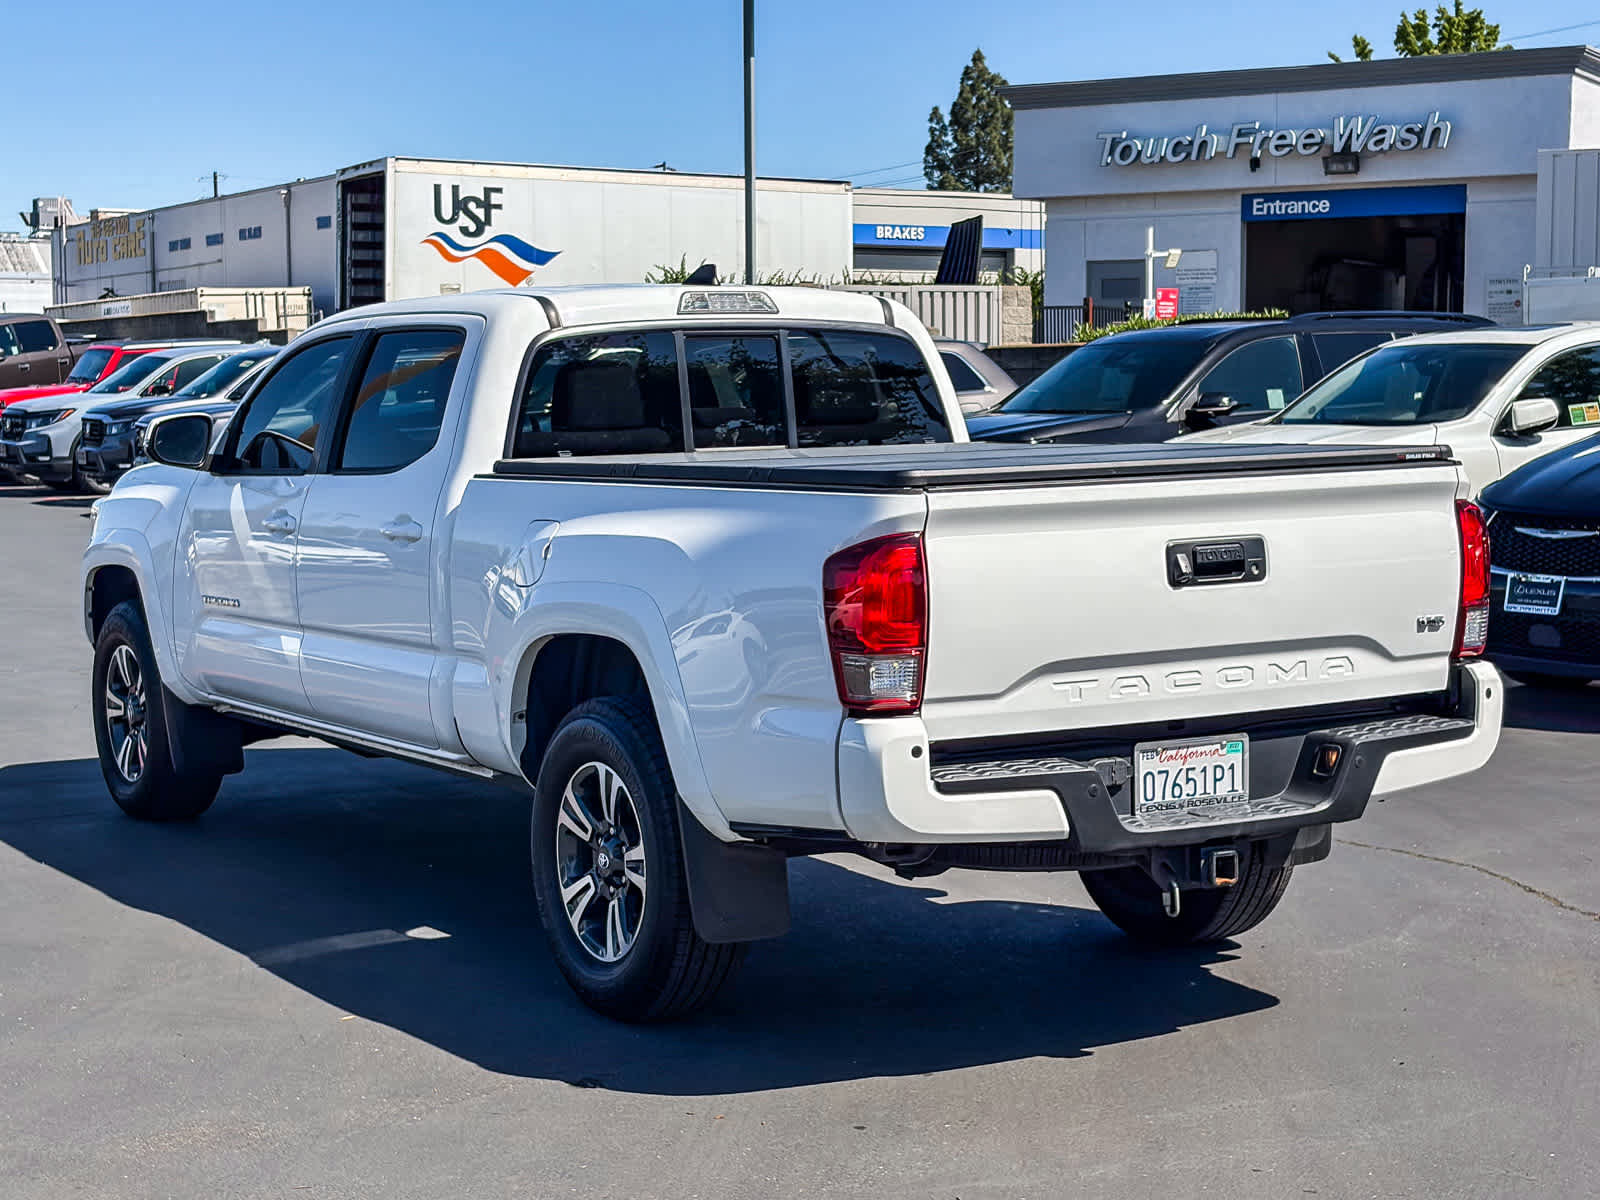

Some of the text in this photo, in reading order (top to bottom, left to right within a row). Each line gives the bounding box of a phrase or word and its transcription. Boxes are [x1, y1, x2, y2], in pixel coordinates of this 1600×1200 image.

[1097, 112, 1452, 168] Touch Free Wash
[434, 183, 503, 238] USF
[1252, 197, 1330, 217] Entrance
[111, 219, 146, 260] CARE
[876, 225, 925, 240] BRAKES
[1200, 548, 1242, 562] TOYOTA
[1051, 655, 1354, 703] TACOMA
[1142, 751, 1156, 761] FEB
[1159, 748, 1226, 766] California
[1143, 762, 1239, 802] 07651P1
[1187, 794, 1248, 809] ROSEVILLE
